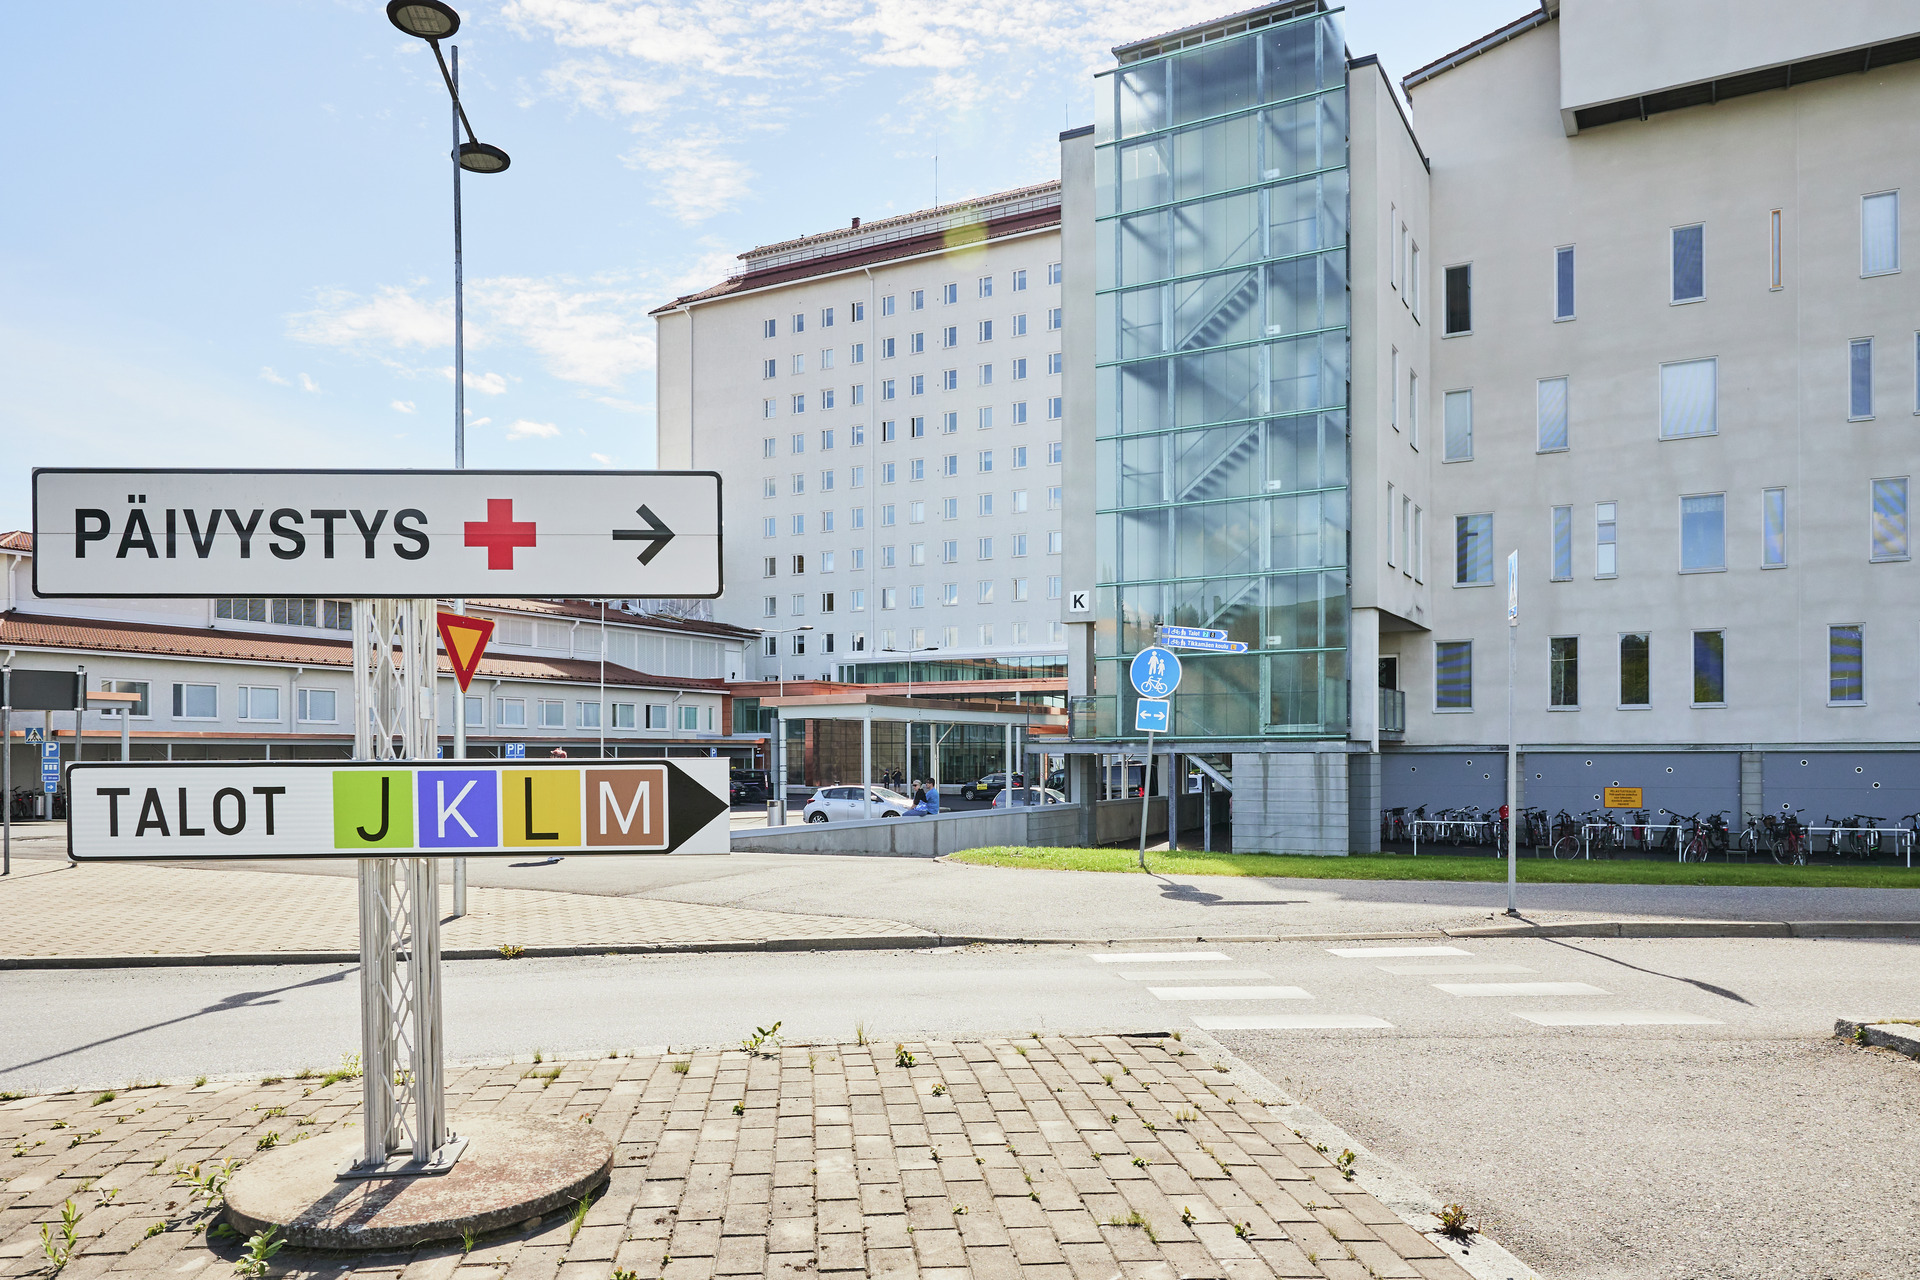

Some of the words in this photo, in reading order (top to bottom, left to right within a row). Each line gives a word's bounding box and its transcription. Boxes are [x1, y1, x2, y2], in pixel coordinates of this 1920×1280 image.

[74, 494, 431, 561] PÄIVYSTYS
[1073, 593, 1085, 609] K
[1188, 640, 1214, 648] Tikkamäen
[45, 742, 57, 757] P
[96, 786, 286, 837] TALOT
[356, 776, 390, 842] J
[437, 780, 478, 838] K
[524, 776, 559, 841] L
[599, 780, 650, 835] M
